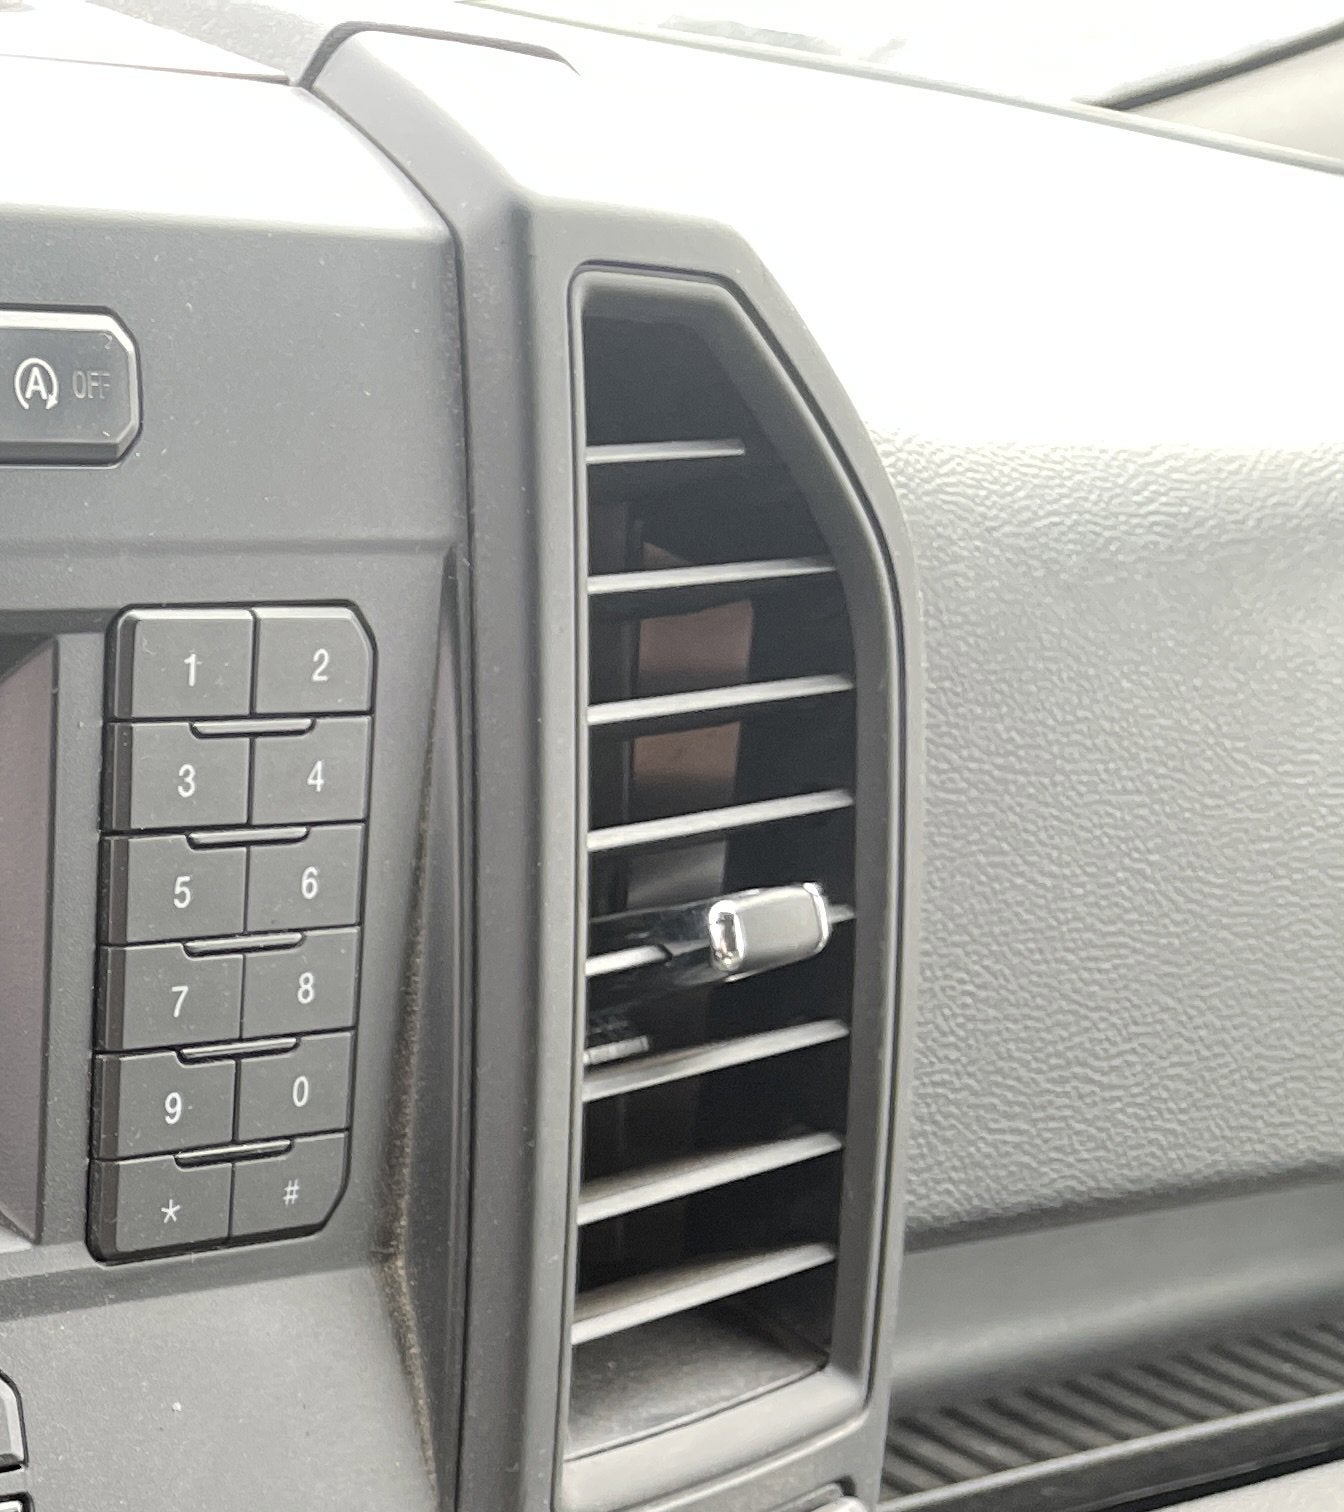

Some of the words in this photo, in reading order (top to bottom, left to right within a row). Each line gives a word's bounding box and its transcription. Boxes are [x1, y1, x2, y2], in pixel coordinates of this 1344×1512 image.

[72, 370, 111, 399] OFF
[184, 654, 196, 686] 1
[312, 649, 329, 682] 2
[178, 764, 196, 797] 3
[307, 761, 324, 792] 4
[174, 876, 191, 908] 5
[302, 867, 319, 899] 6
[172, 986, 188, 1018] 7
[298, 973, 314, 1004] 8
[293, 1076, 309, 1107] 0
[165, 1092, 182, 1124] 9
